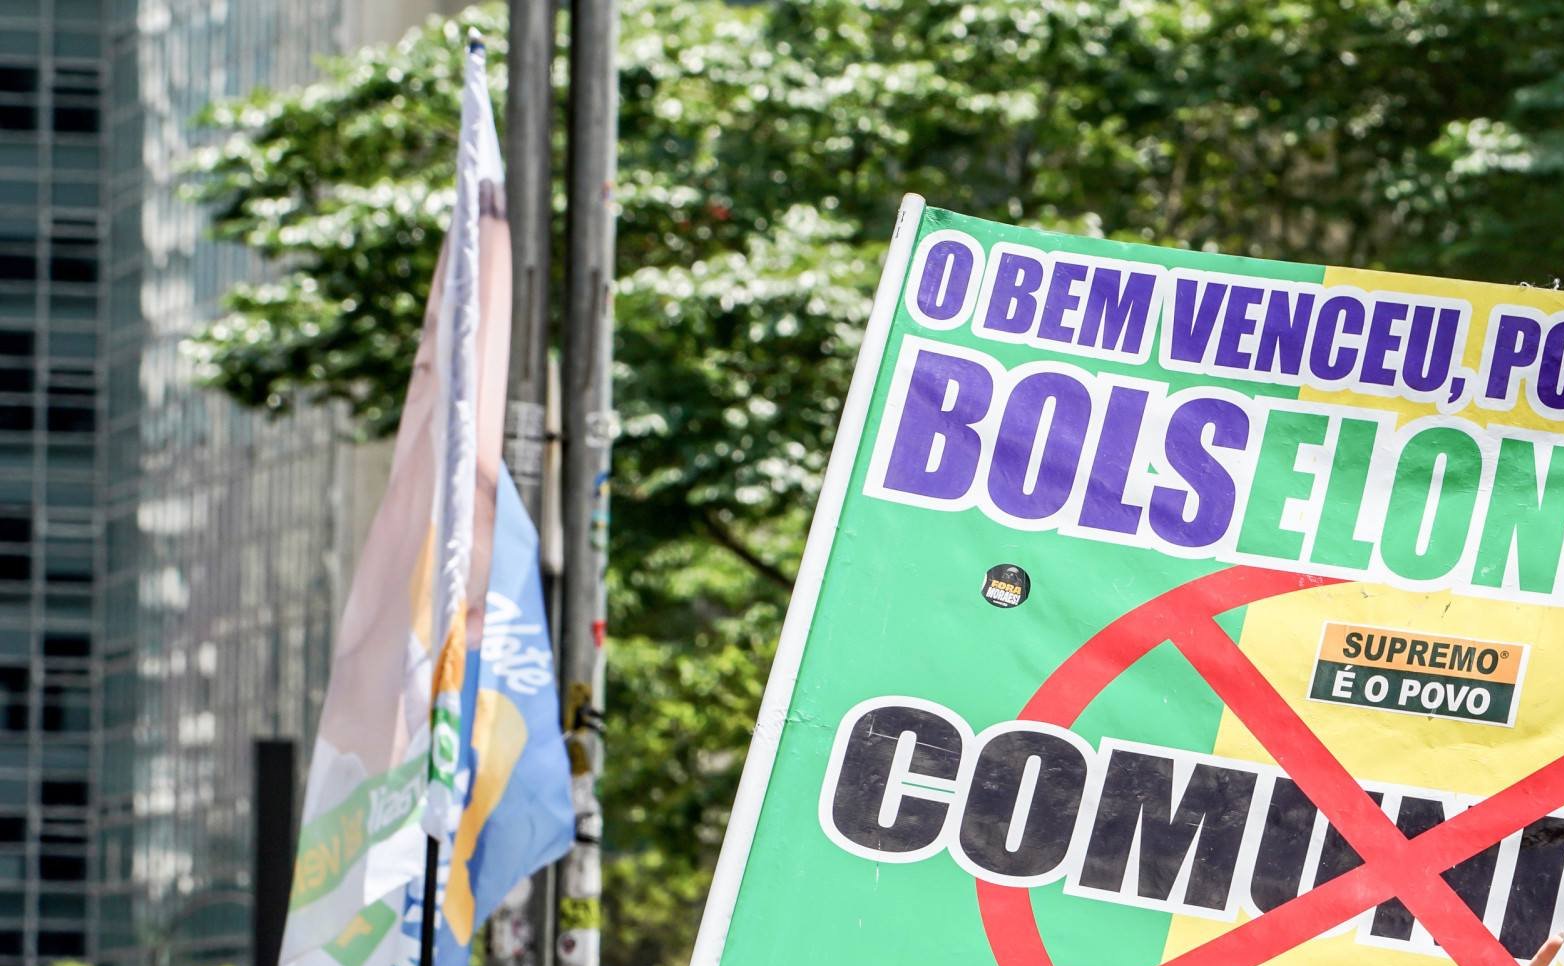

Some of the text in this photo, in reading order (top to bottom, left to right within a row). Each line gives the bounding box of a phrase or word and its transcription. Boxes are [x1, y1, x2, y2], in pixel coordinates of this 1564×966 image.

[917, 240, 974, 321] O
[984, 253, 1157, 354] BEM
[1170, 278, 1462, 404] VENCEU,
[1332, 665, 1491, 716] É O POVO
